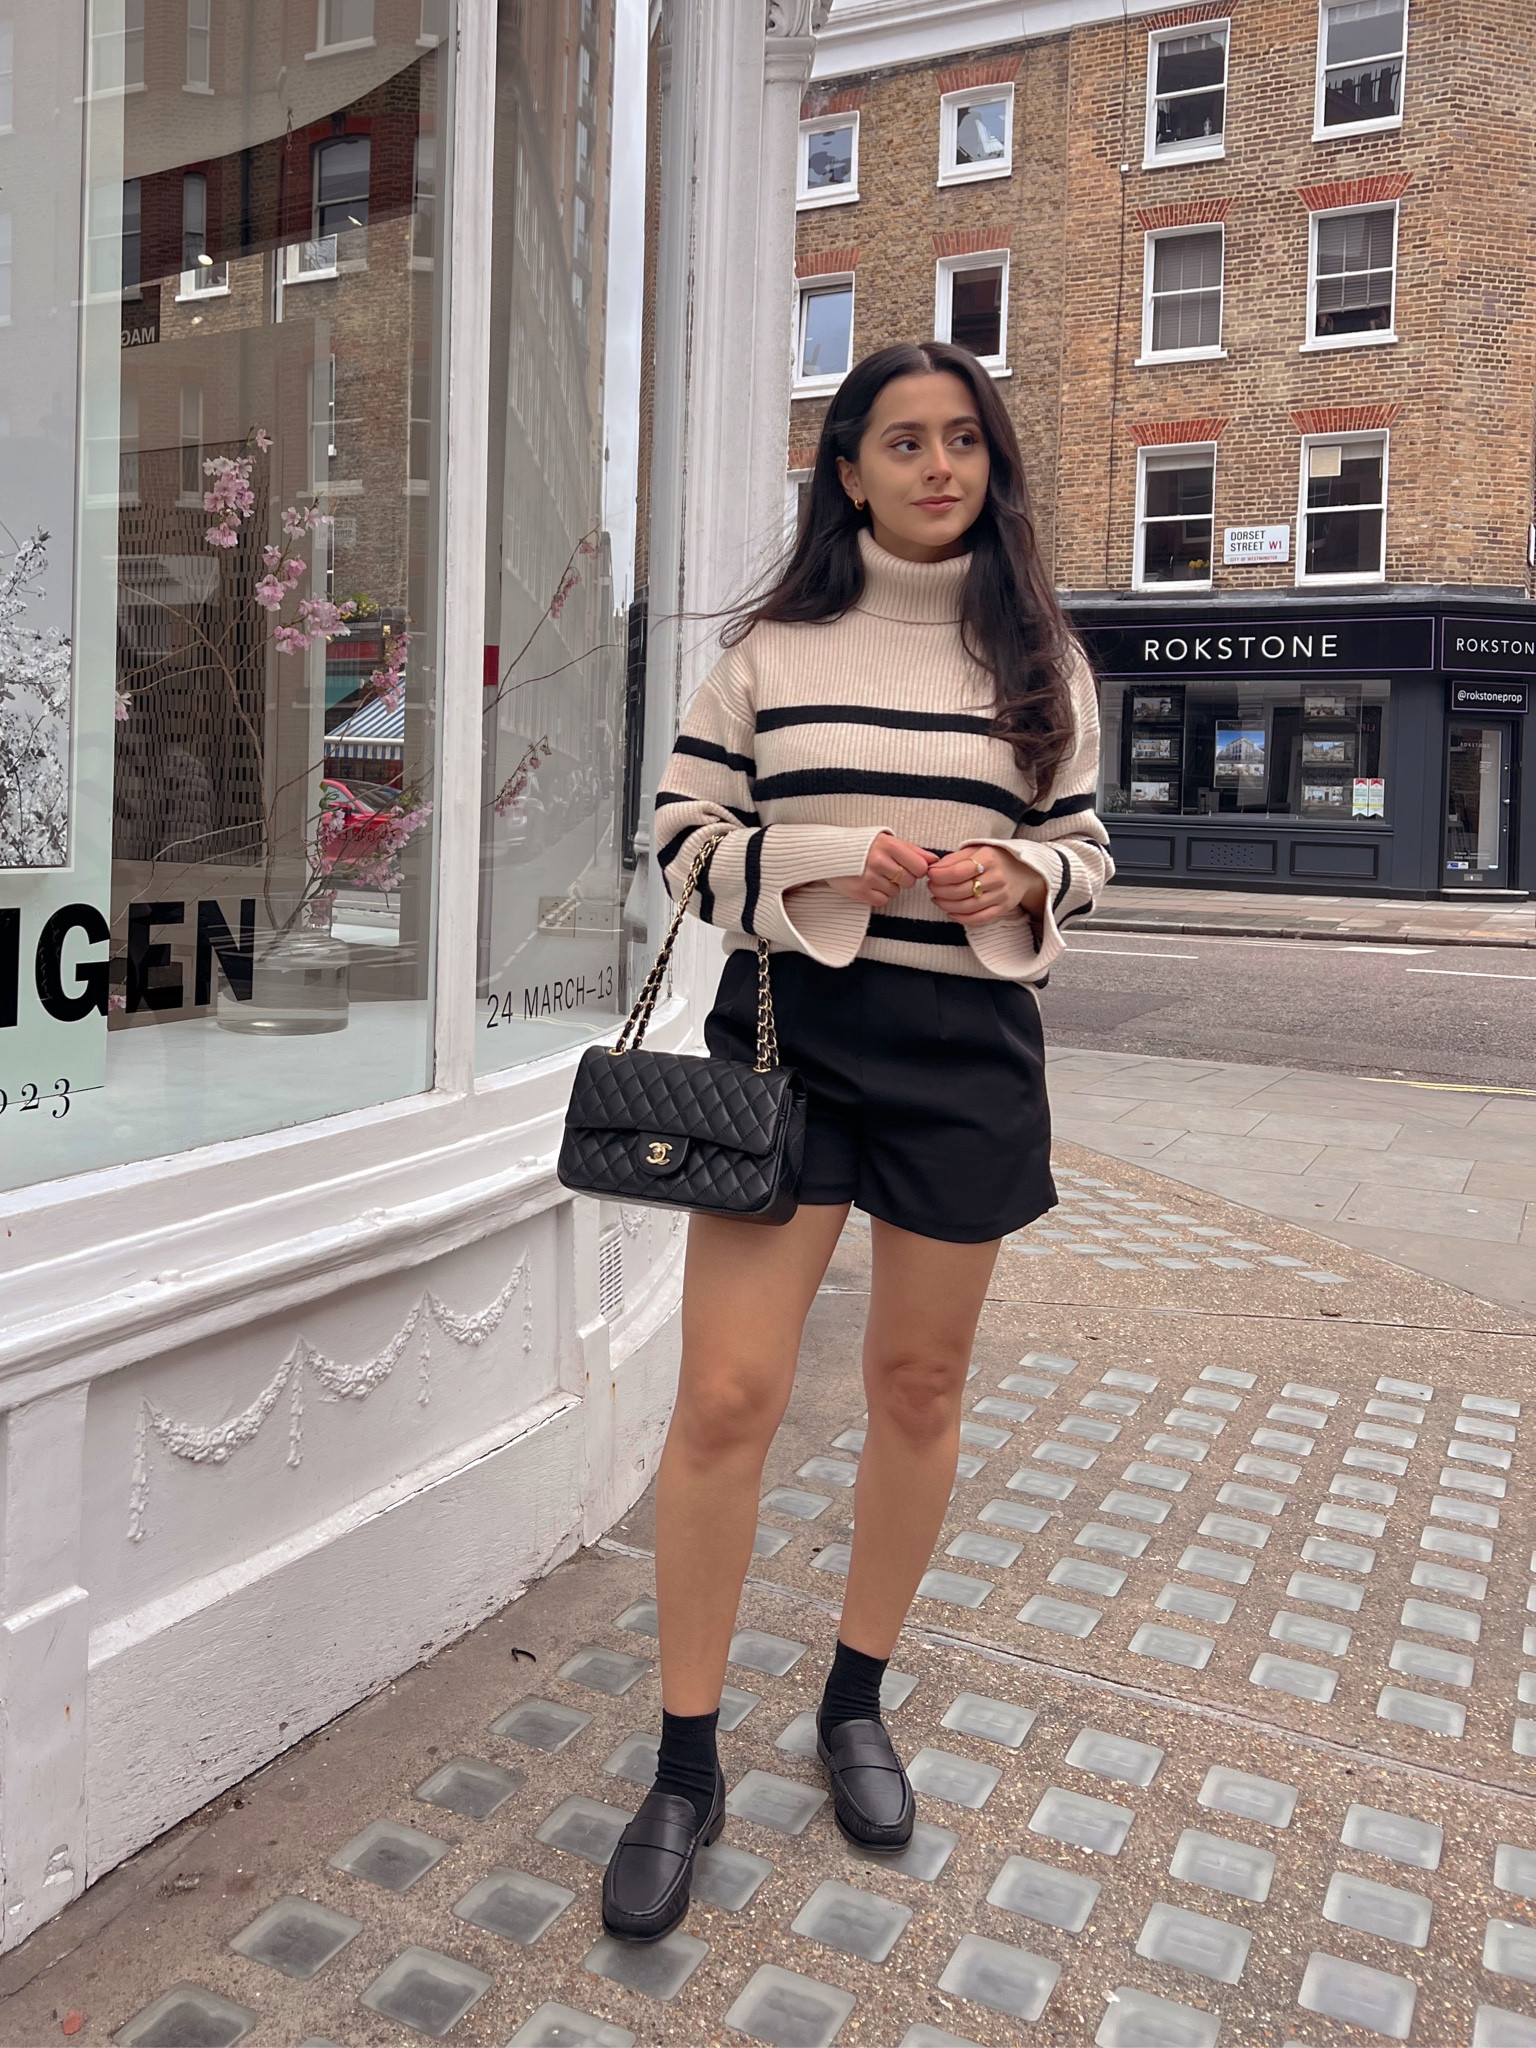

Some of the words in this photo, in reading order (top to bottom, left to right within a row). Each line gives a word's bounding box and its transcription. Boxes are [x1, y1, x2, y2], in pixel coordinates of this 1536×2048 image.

[1230, 530, 1266, 541] DORSET
[1230, 541, 1264, 552] STREET
[1269, 540, 1282, 550] W1
[1144, 634, 1338, 661] ROKSTONE
[1457, 689, 1523, 704] @rokstoneprop
[486, 991, 513, 1029] 24
